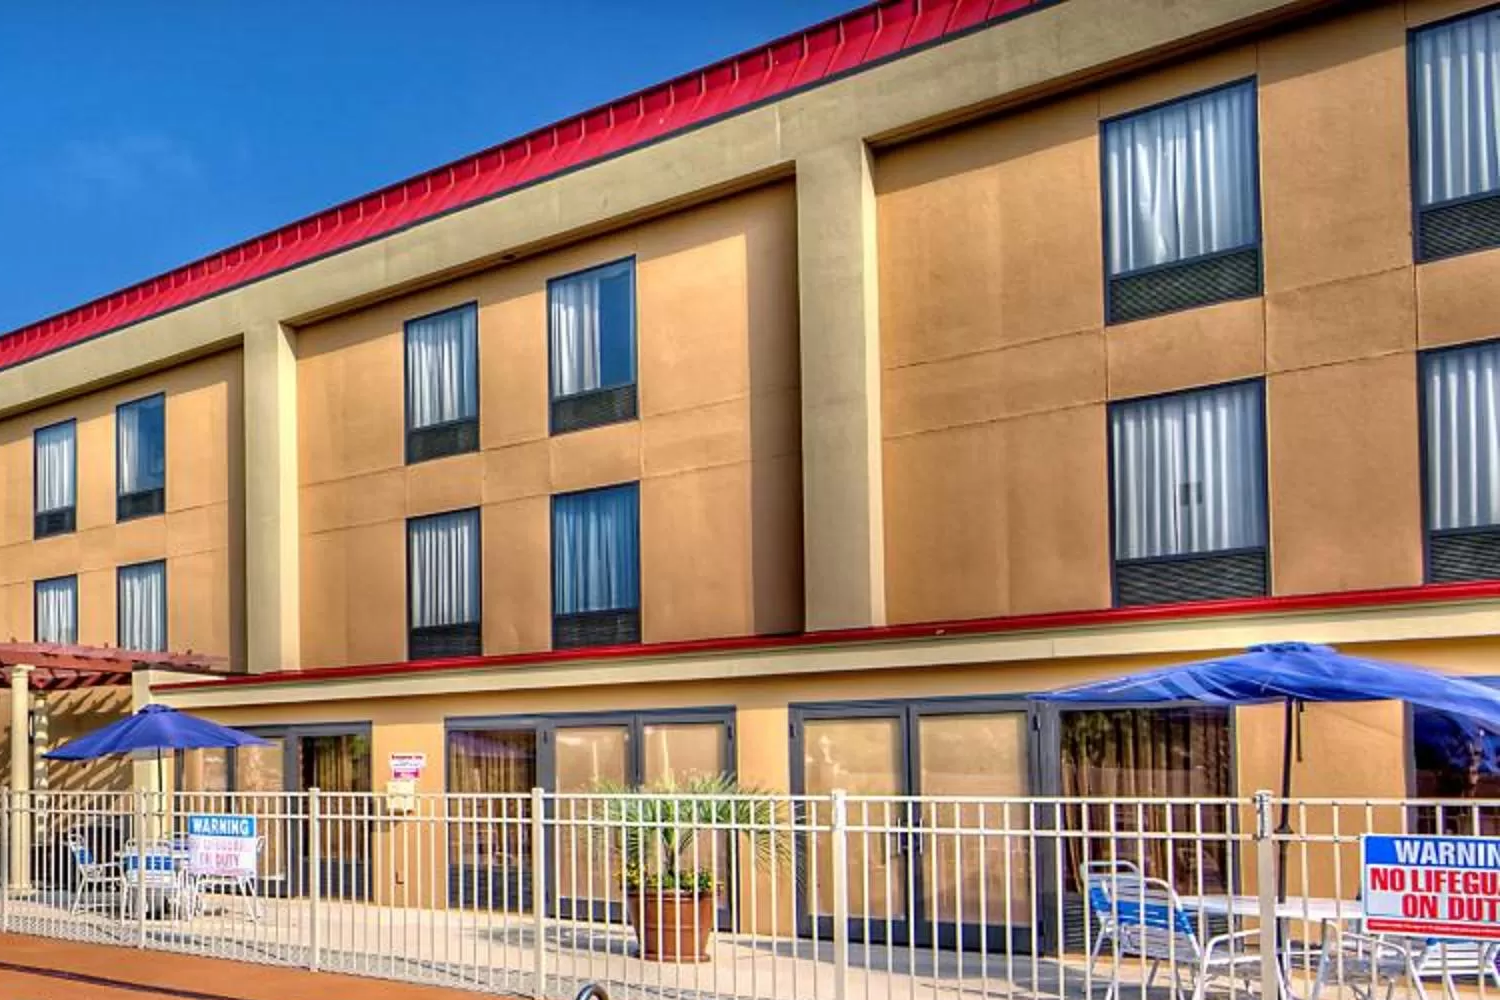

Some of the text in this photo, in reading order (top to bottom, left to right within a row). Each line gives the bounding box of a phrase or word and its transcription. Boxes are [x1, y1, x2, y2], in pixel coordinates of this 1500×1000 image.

[191, 817, 250, 835] WARNING
[1370, 867, 1500, 896] NO LIFEGU
[1402, 894, 1438, 918] ON
